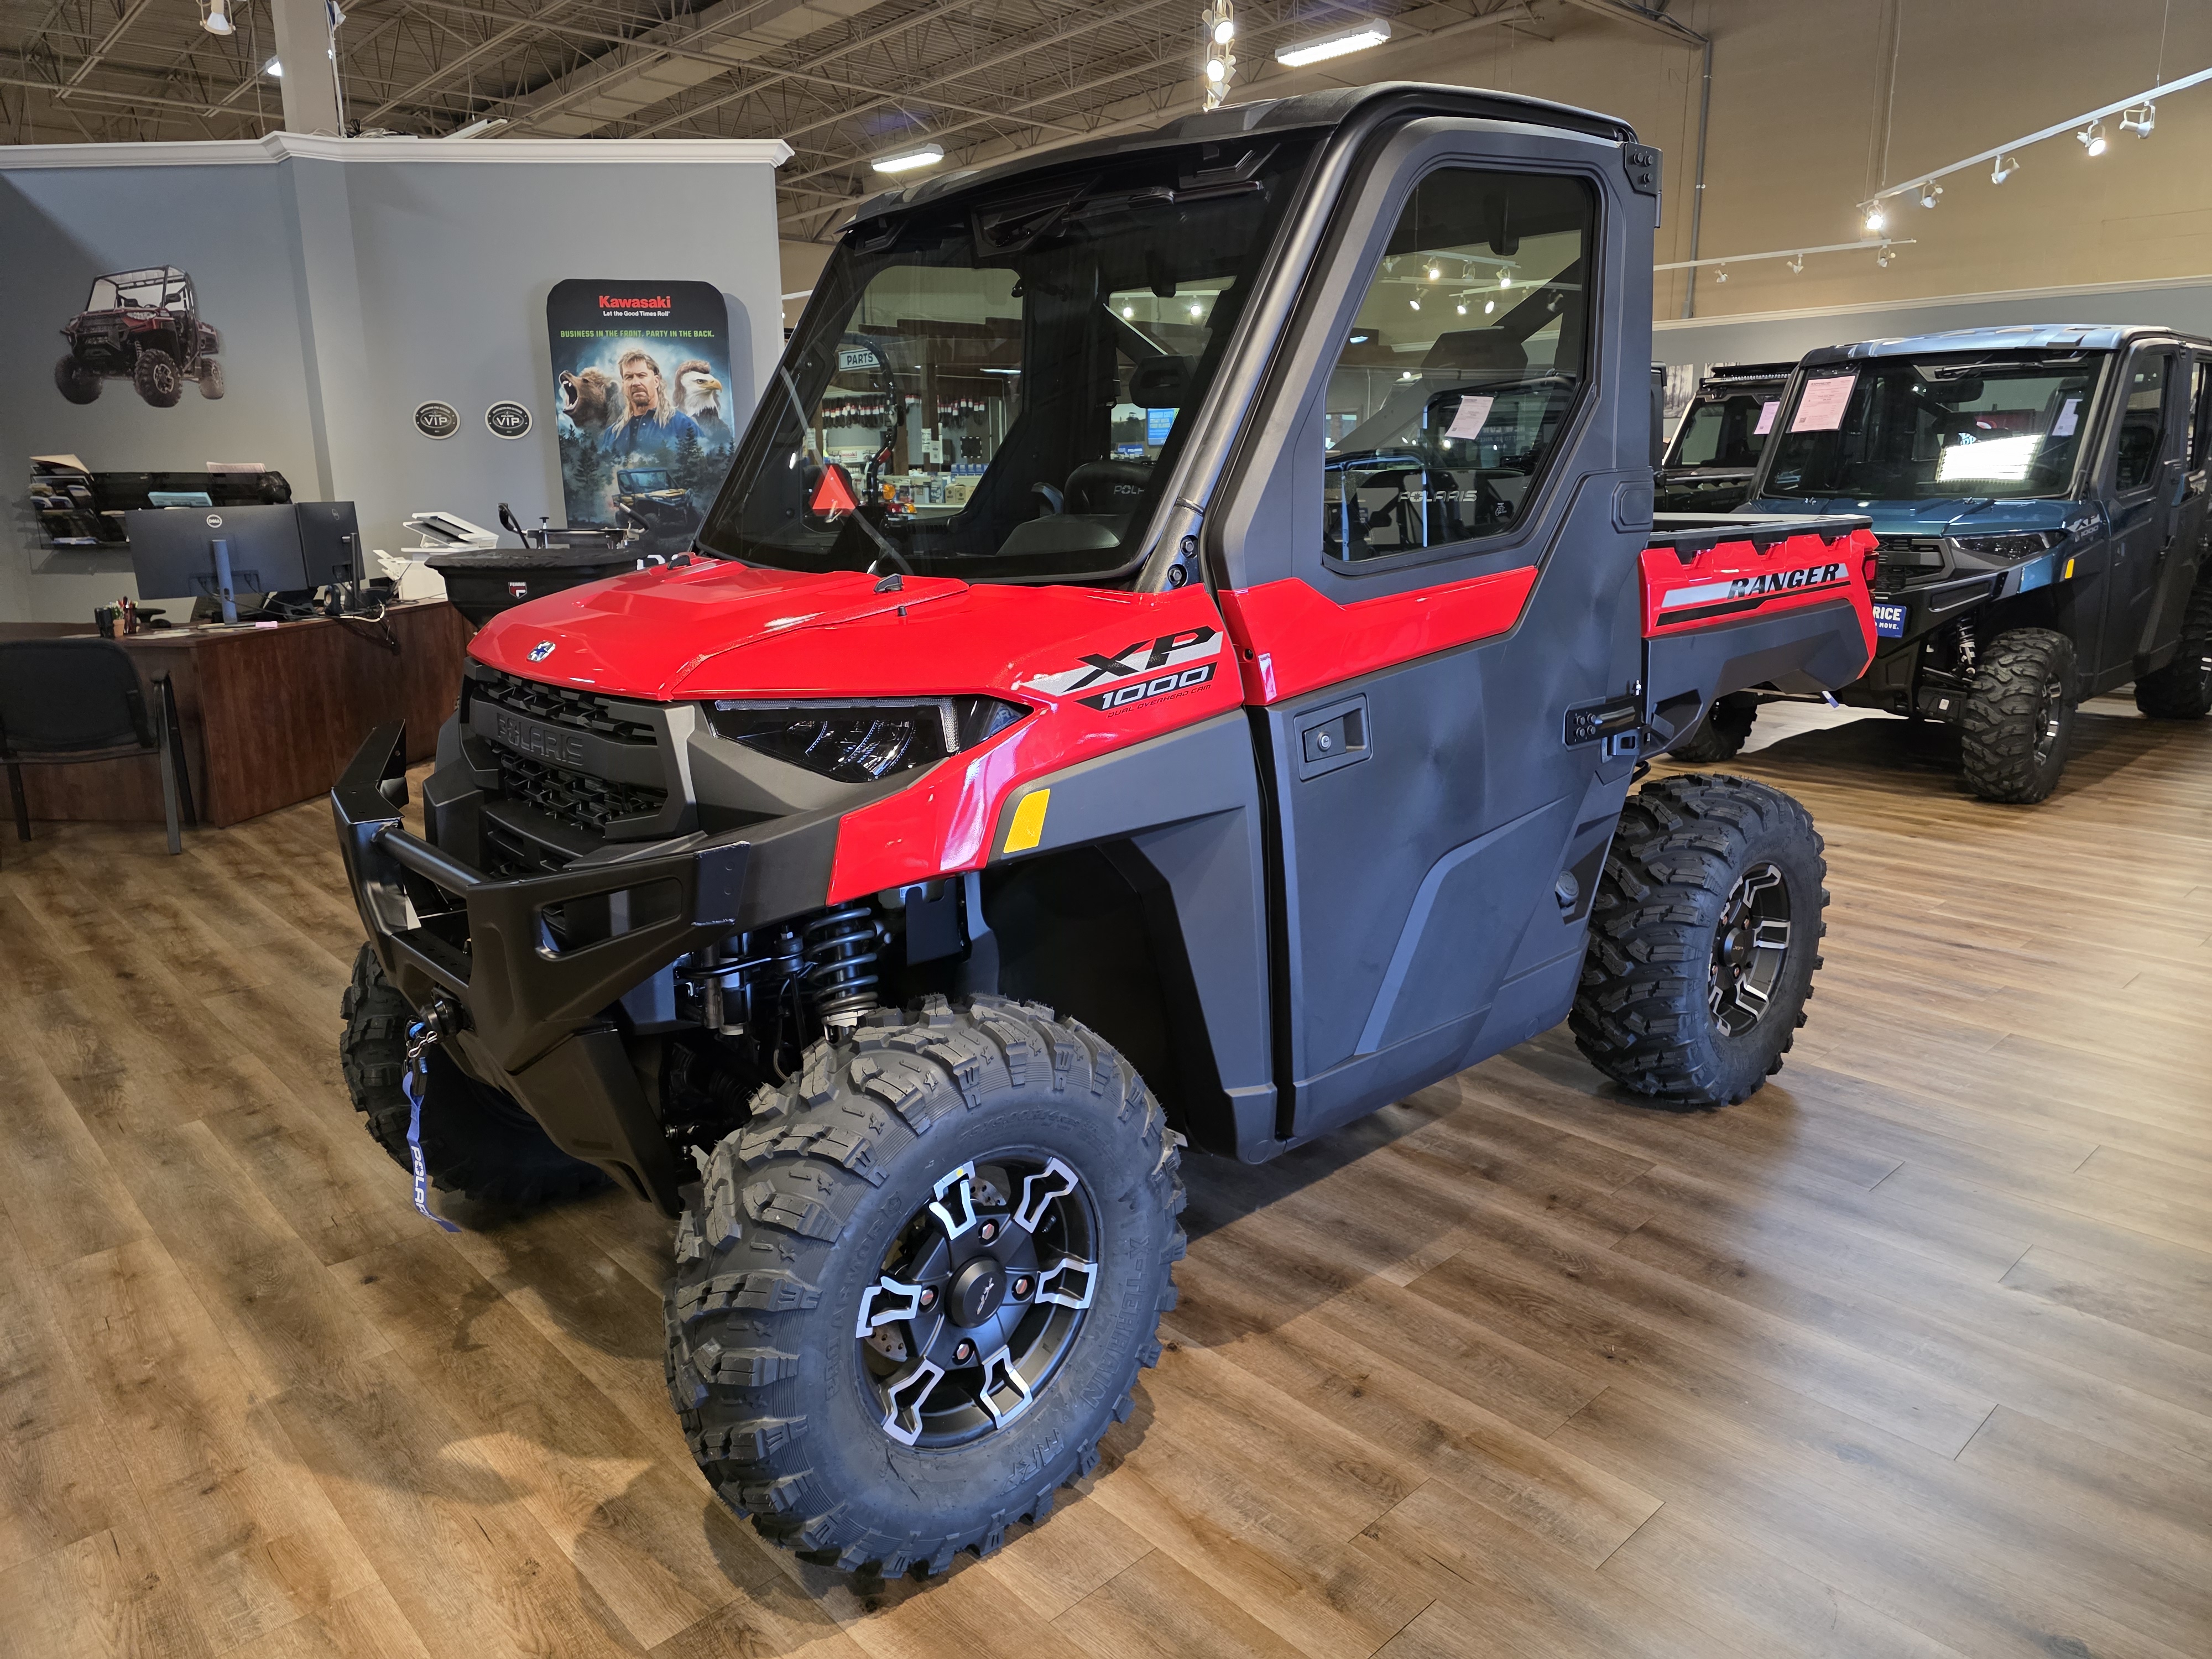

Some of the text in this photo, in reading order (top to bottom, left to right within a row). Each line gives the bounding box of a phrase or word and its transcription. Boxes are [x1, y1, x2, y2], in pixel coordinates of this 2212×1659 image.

[599, 296, 671, 308] Kawasaki
[847, 352, 873, 366] PARTS
[424, 417, 447, 425] VIP
[496, 418, 520, 426] VIP
[1397, 490, 1477, 502] POLARIS
[2081, 525, 2099, 538] 1000
[1726, 563, 1840, 599] RANGER
[1879, 622, 1900, 630] MOVE.
[1062, 625, 1217, 693] XP
[1102, 665, 1209, 710] 1000
[1107, 684, 1211, 719] DUAL OVERHEAD CAM
[497, 712, 584, 766] POLARIS
[1079, 1234, 1150, 1409] X-TERRAIN
